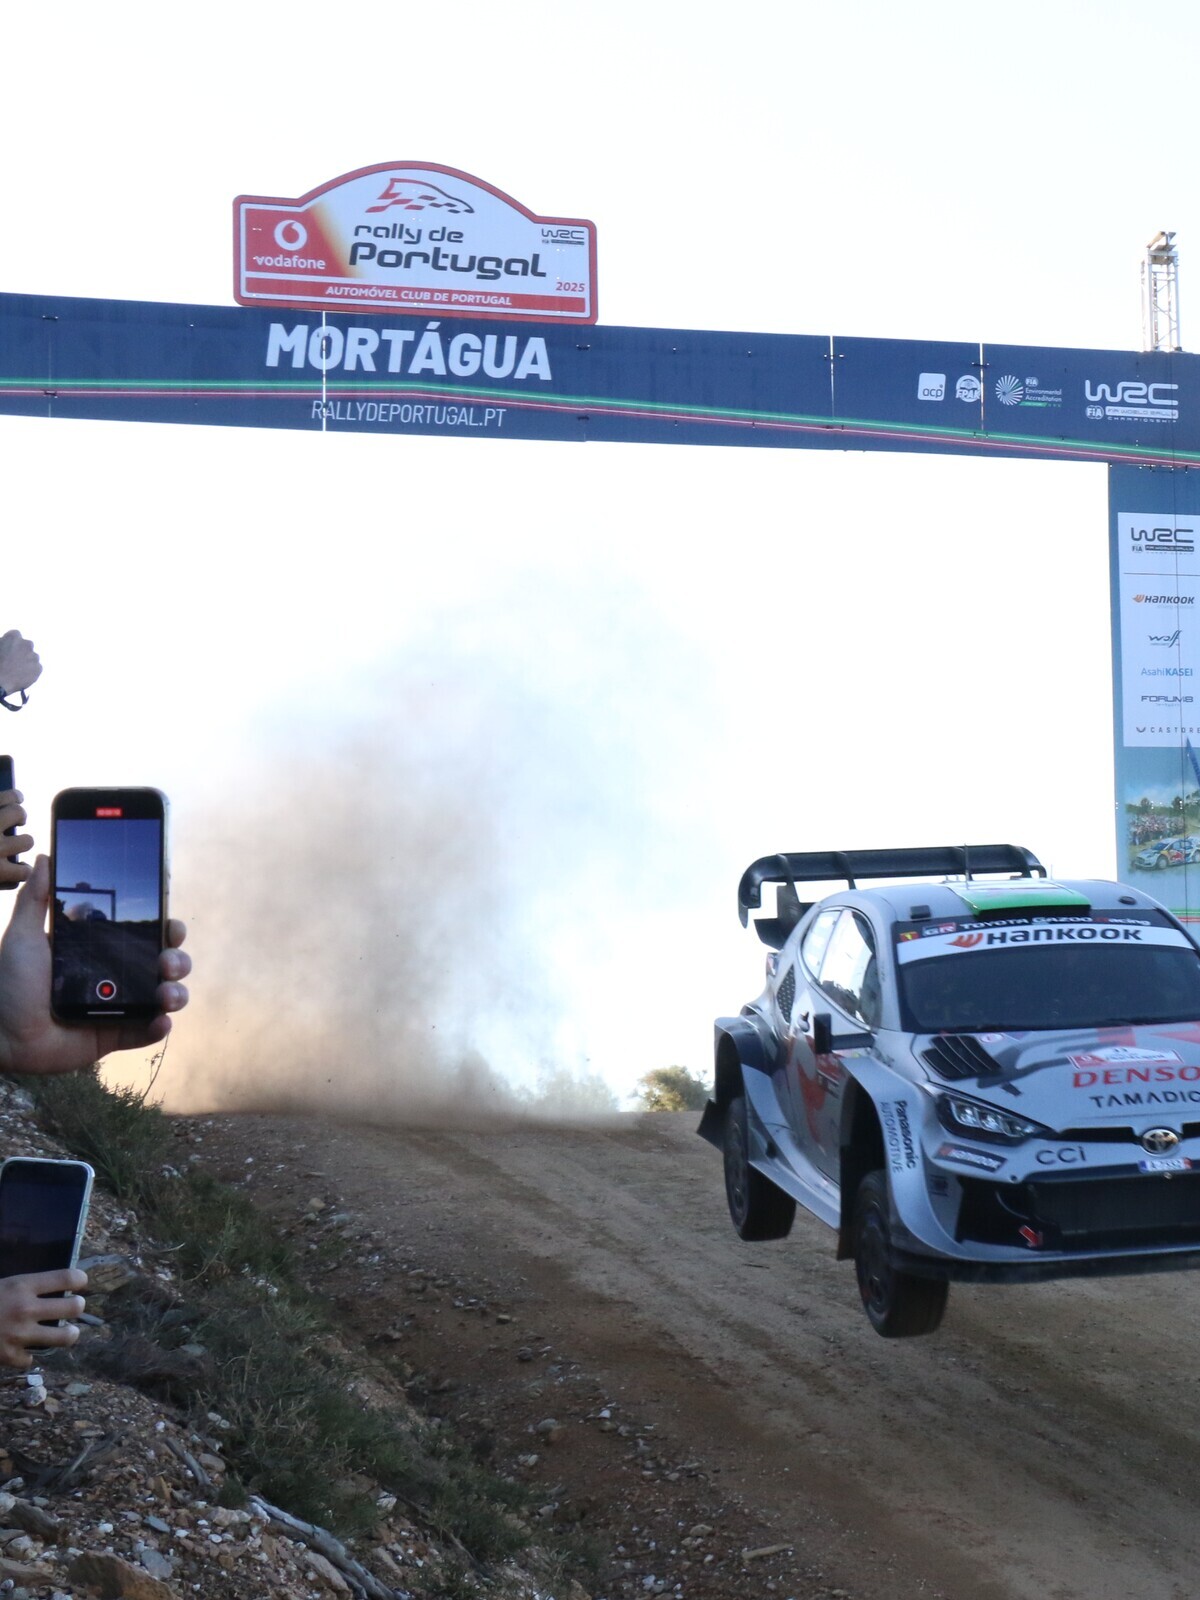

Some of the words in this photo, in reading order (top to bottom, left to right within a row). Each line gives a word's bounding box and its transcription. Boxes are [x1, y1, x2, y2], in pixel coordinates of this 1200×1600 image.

[354, 222, 422, 245] rally
[428, 226, 464, 243] de
[541, 228, 584, 240] WRC
[255, 254, 326, 270] vodafone
[349, 241, 547, 280] Portugal
[556, 281, 586, 292] 2025
[325, 286, 398, 299] AUTOMÓVEL
[401, 290, 431, 301] CLUB
[433, 292, 449, 302] DE
[451, 294, 512, 305] PORTUGAL
[265, 321, 552, 380] MORTÁGUA
[922, 387, 943, 399] acp
[955, 388, 981, 400] FPAK
[1085, 379, 1178, 406] WRC
[311, 400, 507, 427] RALLYDEPORTUGAL.PT
[1131, 527, 1194, 543] WRC
[1150, 726, 1200, 734] CASTORE
[960, 918, 1029, 929] TOYOTA
[893, 1100, 919, 1169] Panasonic
